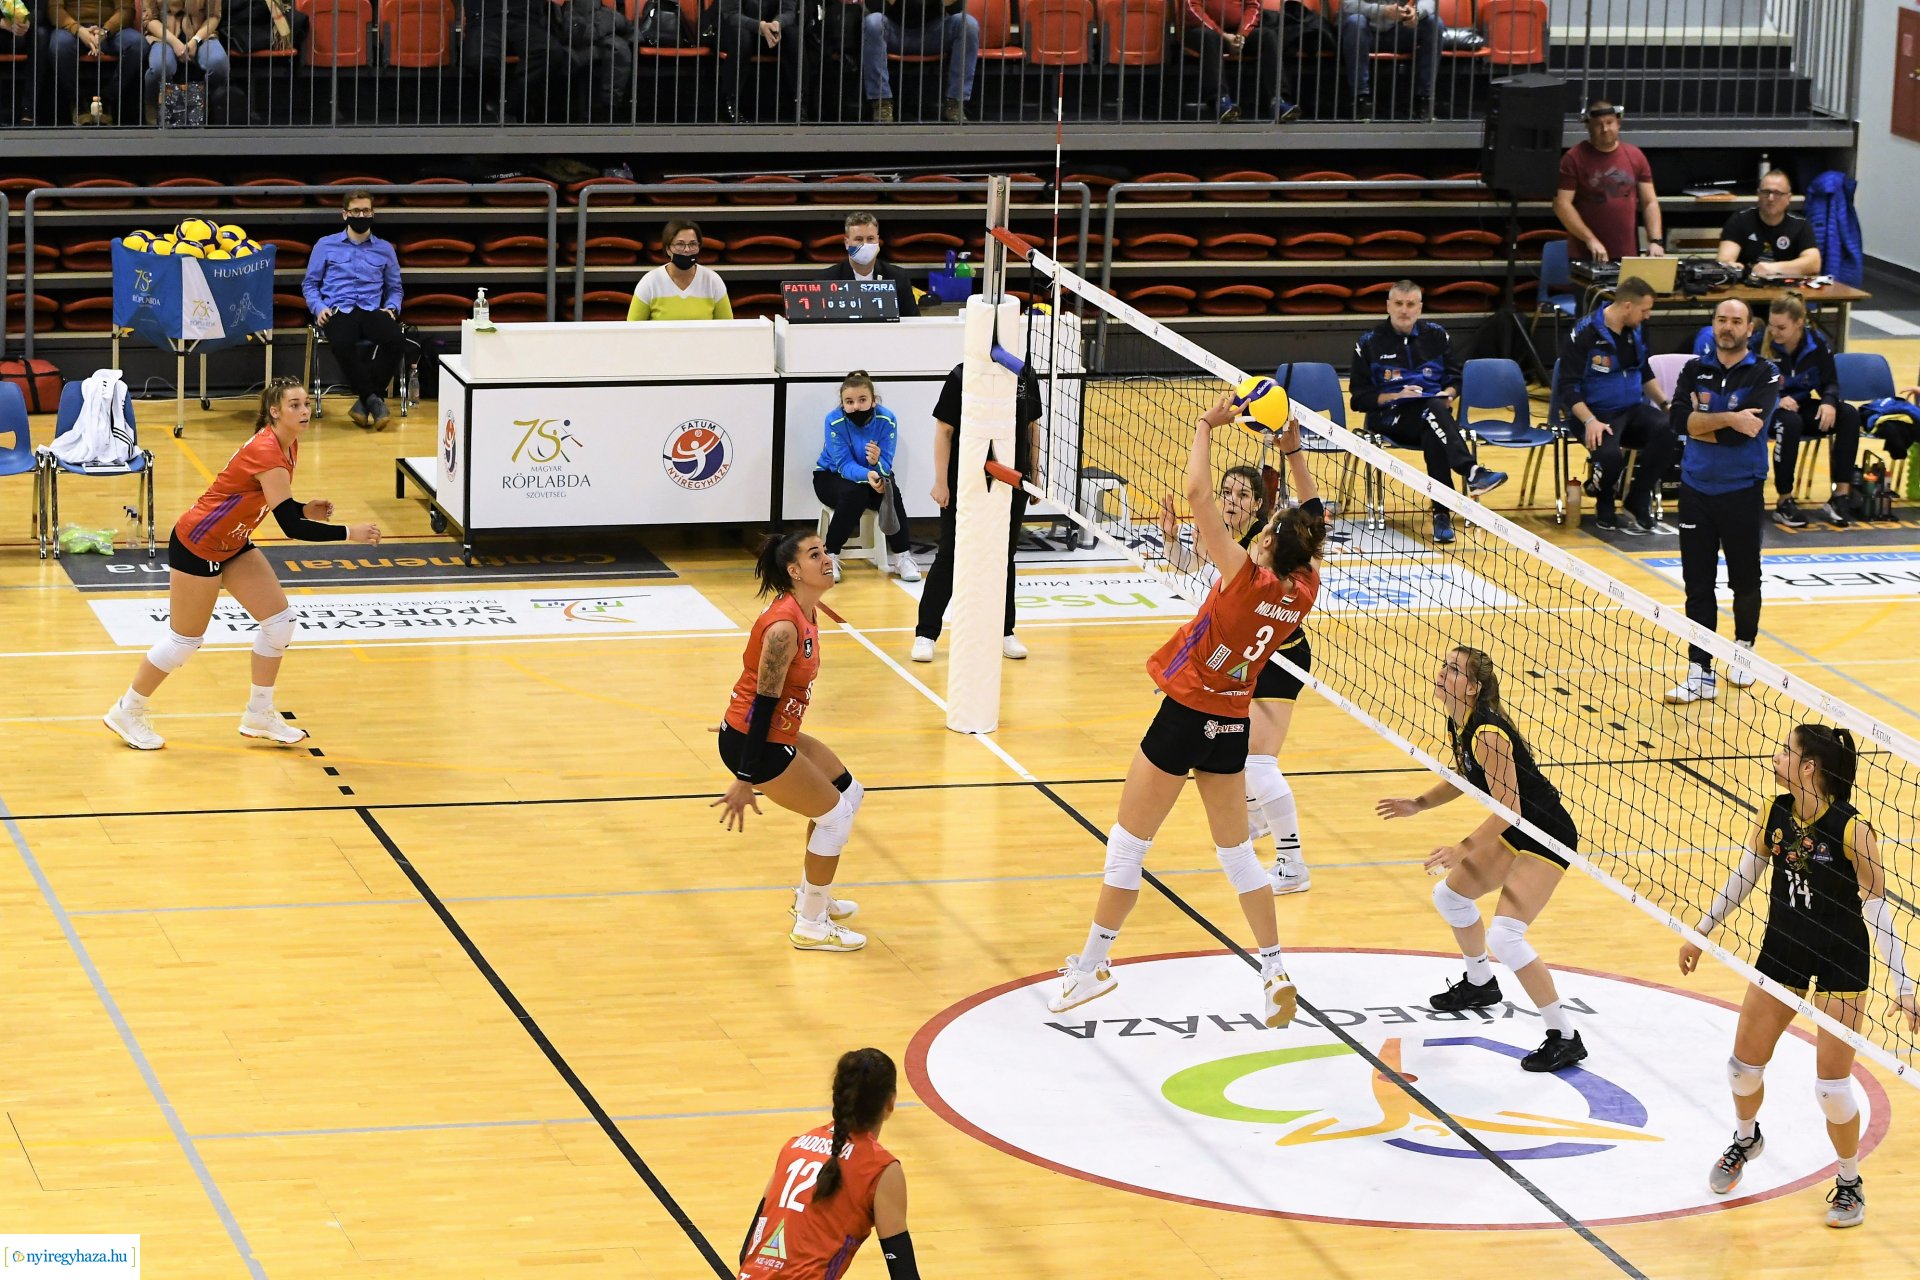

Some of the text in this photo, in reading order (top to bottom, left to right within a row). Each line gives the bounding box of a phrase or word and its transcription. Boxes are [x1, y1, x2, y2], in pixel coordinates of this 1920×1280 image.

[213, 258, 272, 279] HUNVOLLEY
[784, 284, 821, 292] FATUM
[681, 420, 717, 432] FATUM
[530, 465, 563, 473] MAGYAR
[667, 462, 730, 490] NYÍREGYHÁZA
[502, 472, 591, 489] RÖPLABDA
[526, 491, 567, 499] SZÖVETSÉG
[284, 553, 618, 572] Continental
[1079, 578, 1165, 586] orrekt.
[227, 616, 517, 632] NYÍREGYHZI
[1243, 624, 1275, 662] 3
[1872, 722, 1892, 745] FATUM
[1785, 869, 1814, 910] 14
[778, 1157, 824, 1213] 12
